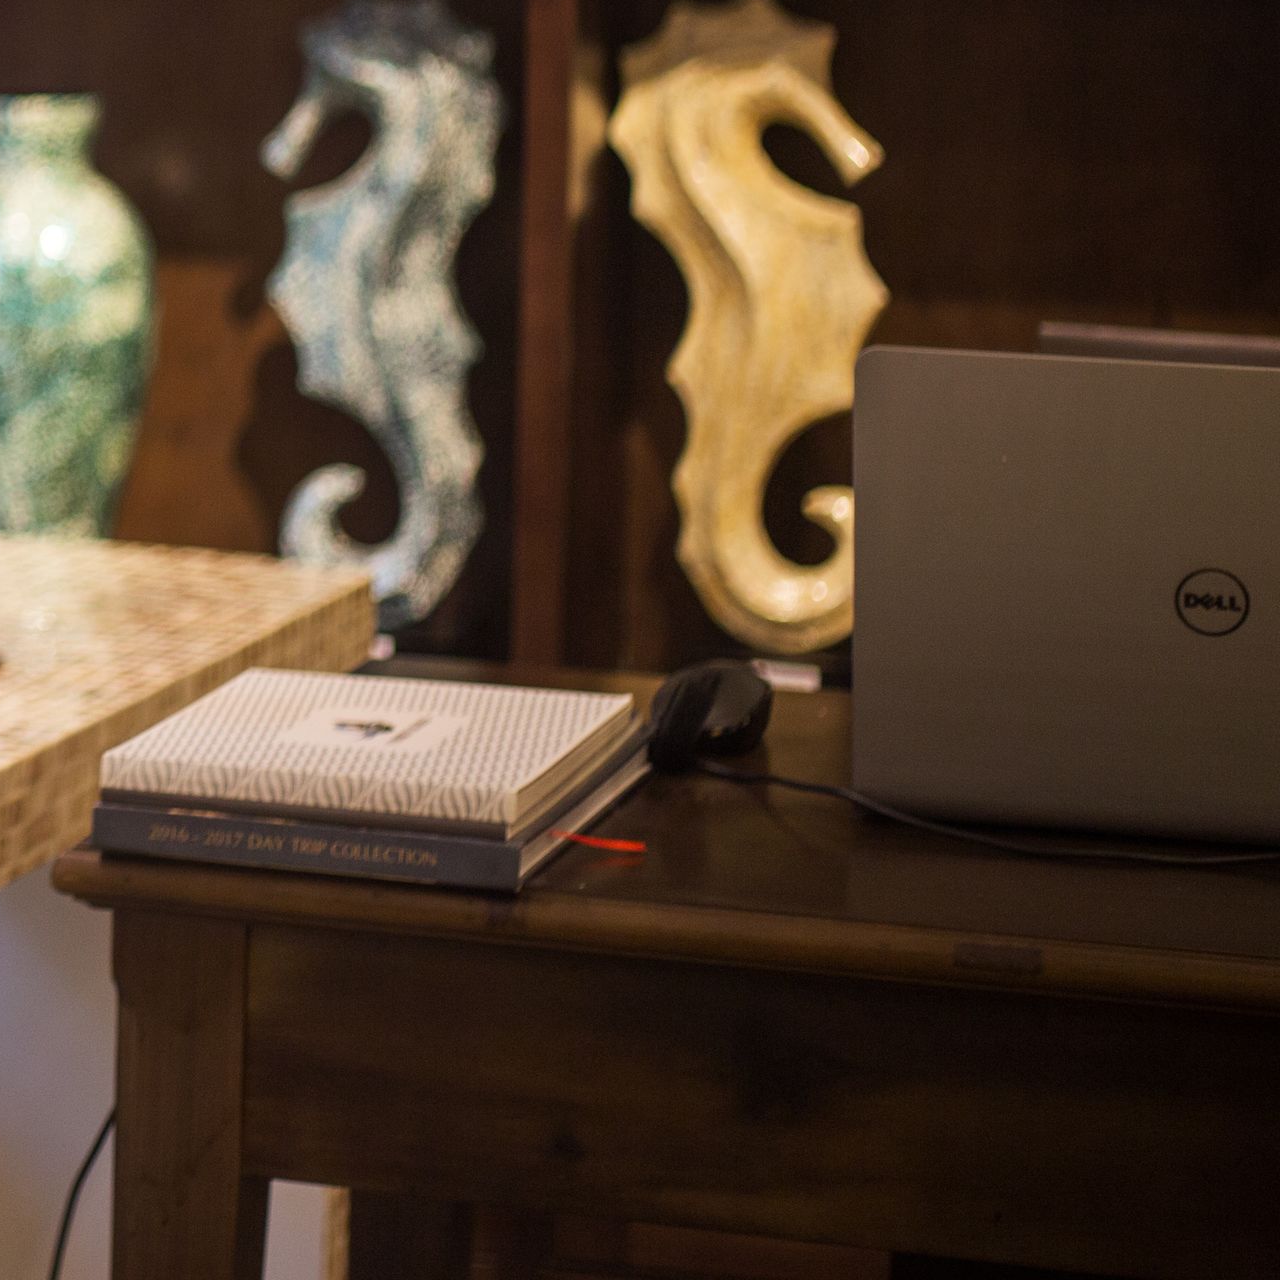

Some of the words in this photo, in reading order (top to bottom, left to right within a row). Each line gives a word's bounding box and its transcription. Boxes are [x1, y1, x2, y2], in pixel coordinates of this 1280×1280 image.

[1183, 592, 1242, 612] DELL
[147, 824, 190, 843] 2016
[203, 829, 245, 849] 2017
[247, 832, 286, 851] DAY
[291, 836, 328, 856] TRIP
[329, 841, 439, 867] COLLECTION
